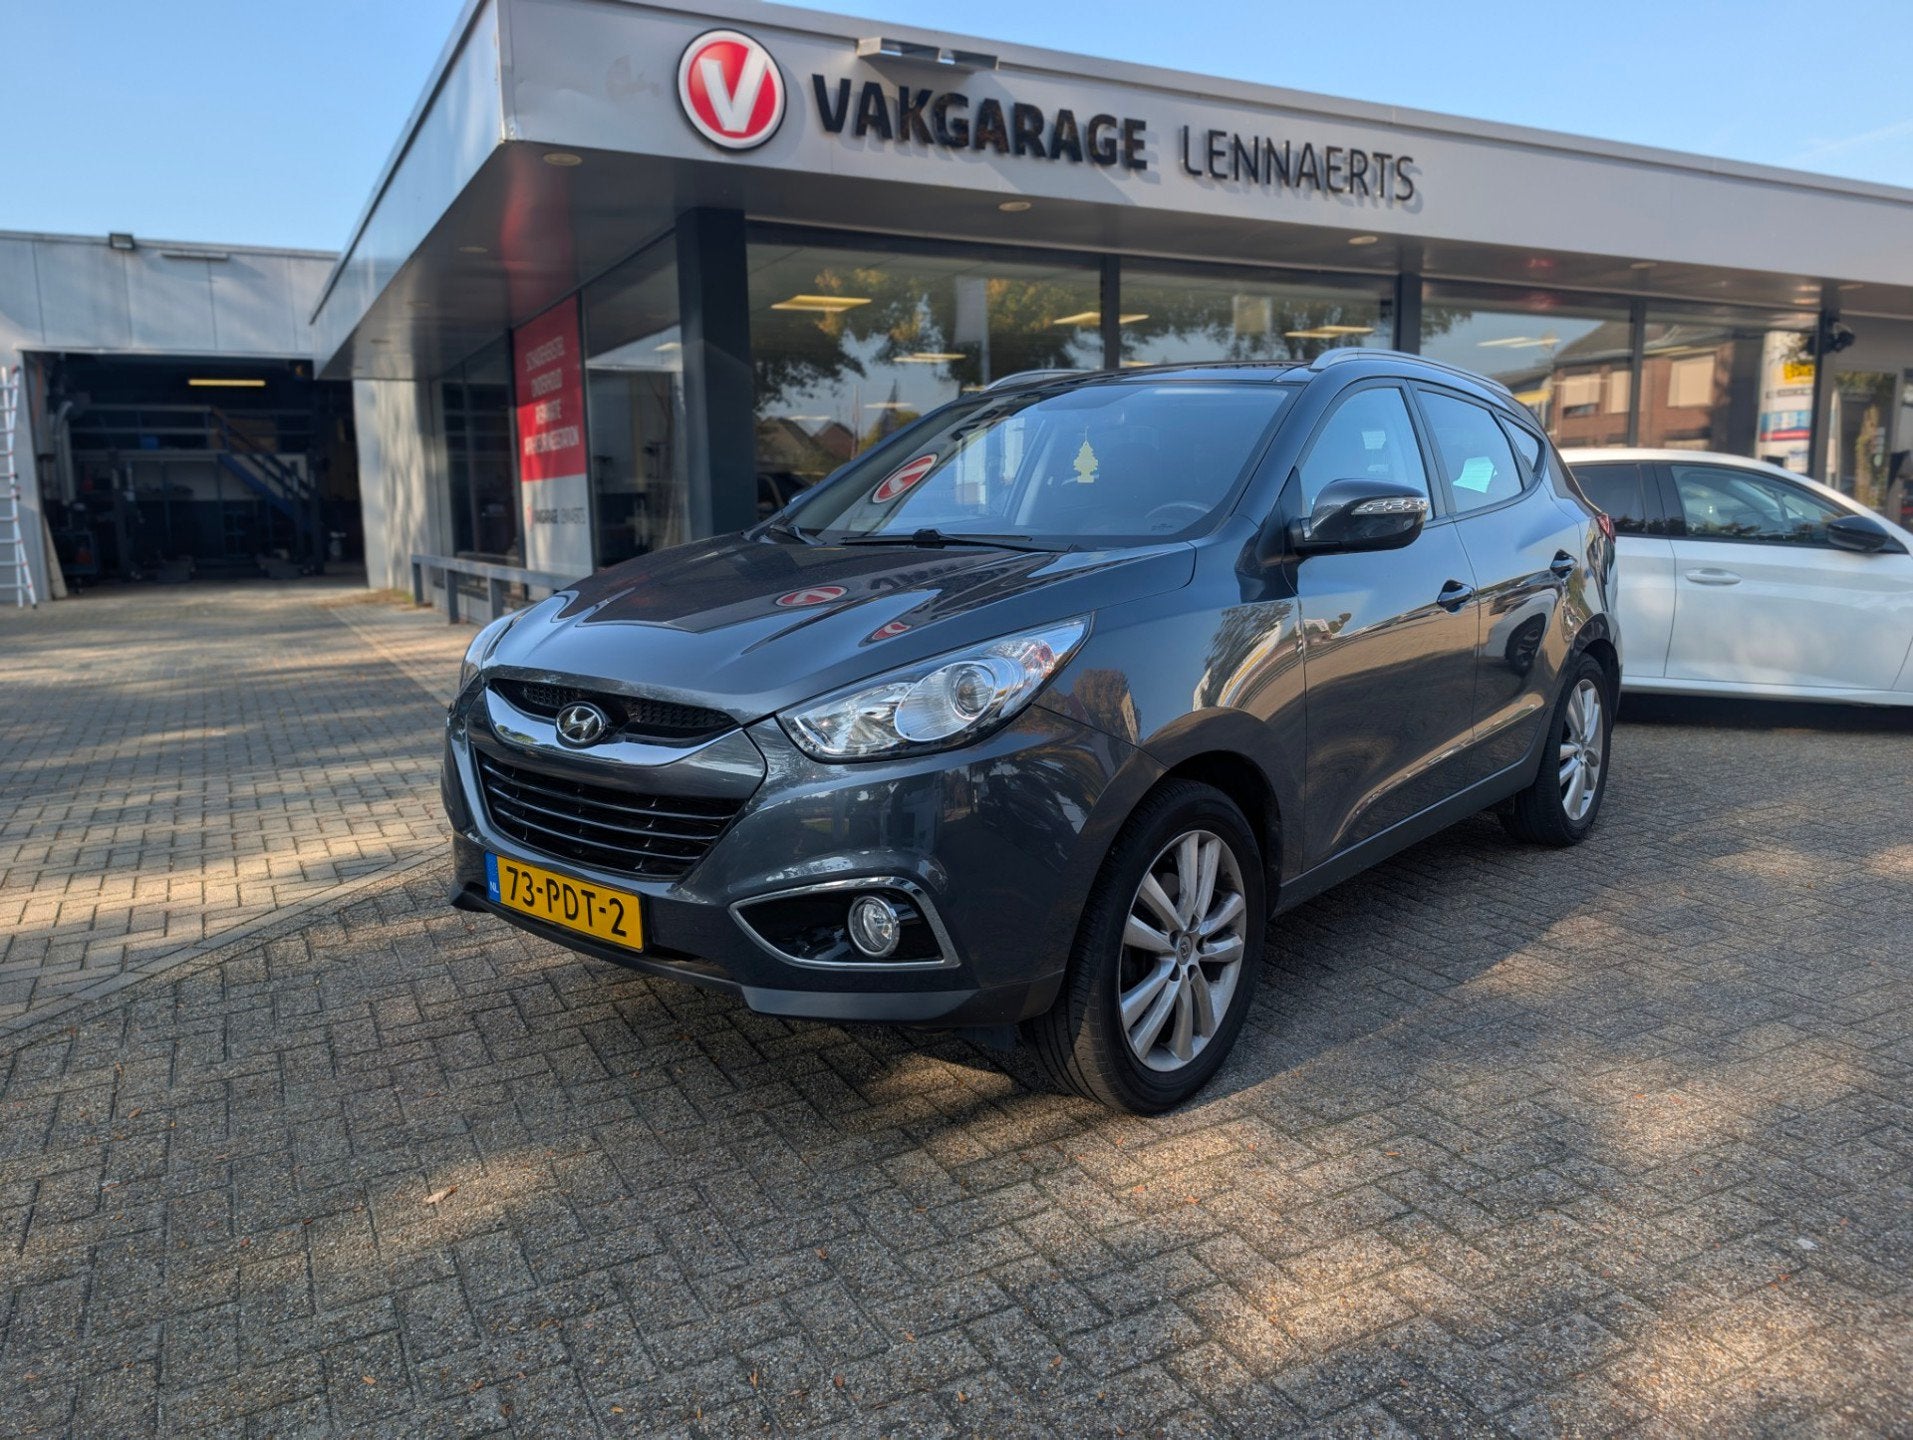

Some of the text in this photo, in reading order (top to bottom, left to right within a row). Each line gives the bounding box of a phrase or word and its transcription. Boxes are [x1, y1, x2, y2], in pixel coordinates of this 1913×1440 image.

[698, 43, 769, 134] V
[811, 73, 1414, 201] VAKGARAGE LENNAERTS
[489, 881, 499, 894] NL
[505, 865, 627, 938] 73-PDT-2
